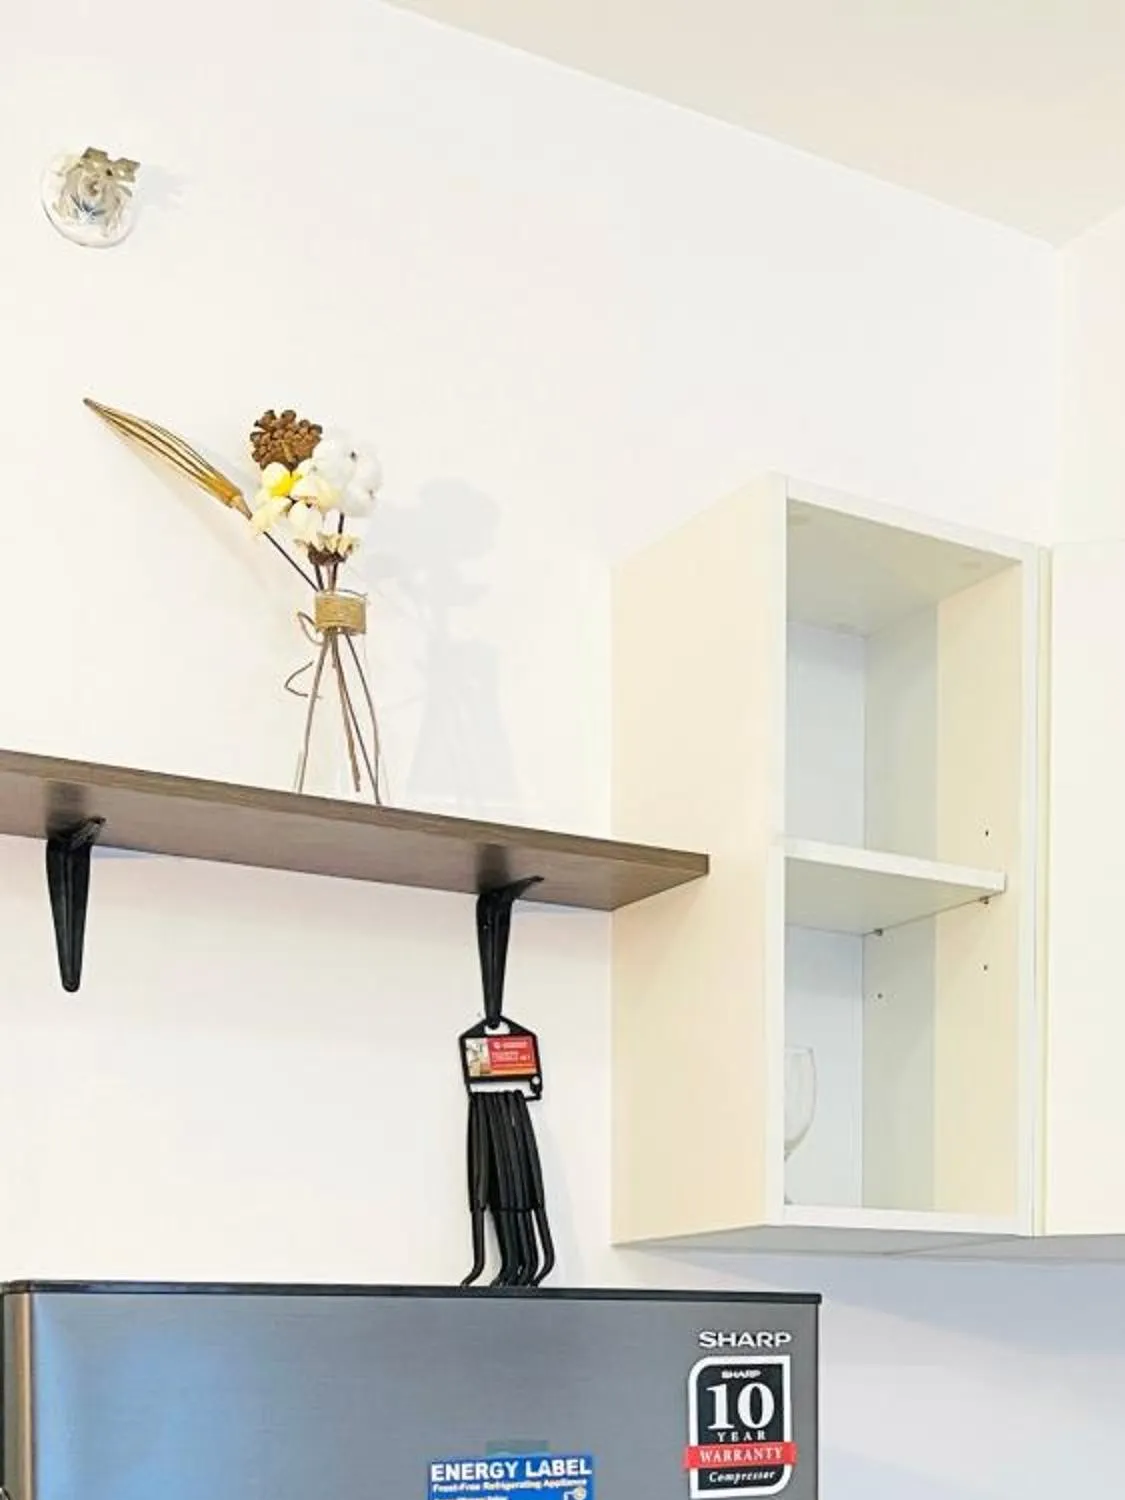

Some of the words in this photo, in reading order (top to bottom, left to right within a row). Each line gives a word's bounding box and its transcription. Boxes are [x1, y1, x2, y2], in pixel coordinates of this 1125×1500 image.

[699, 1331, 792, 1349] SHARP
[721, 1369, 762, 1380] SHARP
[706, 1382, 775, 1430] 10
[716, 1429, 767, 1443] YEAR
[700, 1446, 784, 1463] WARRANTY
[431, 1460, 519, 1482] ENERGY
[525, 1458, 593, 1478] LABEL
[708, 1469, 777, 1485] Compressor
